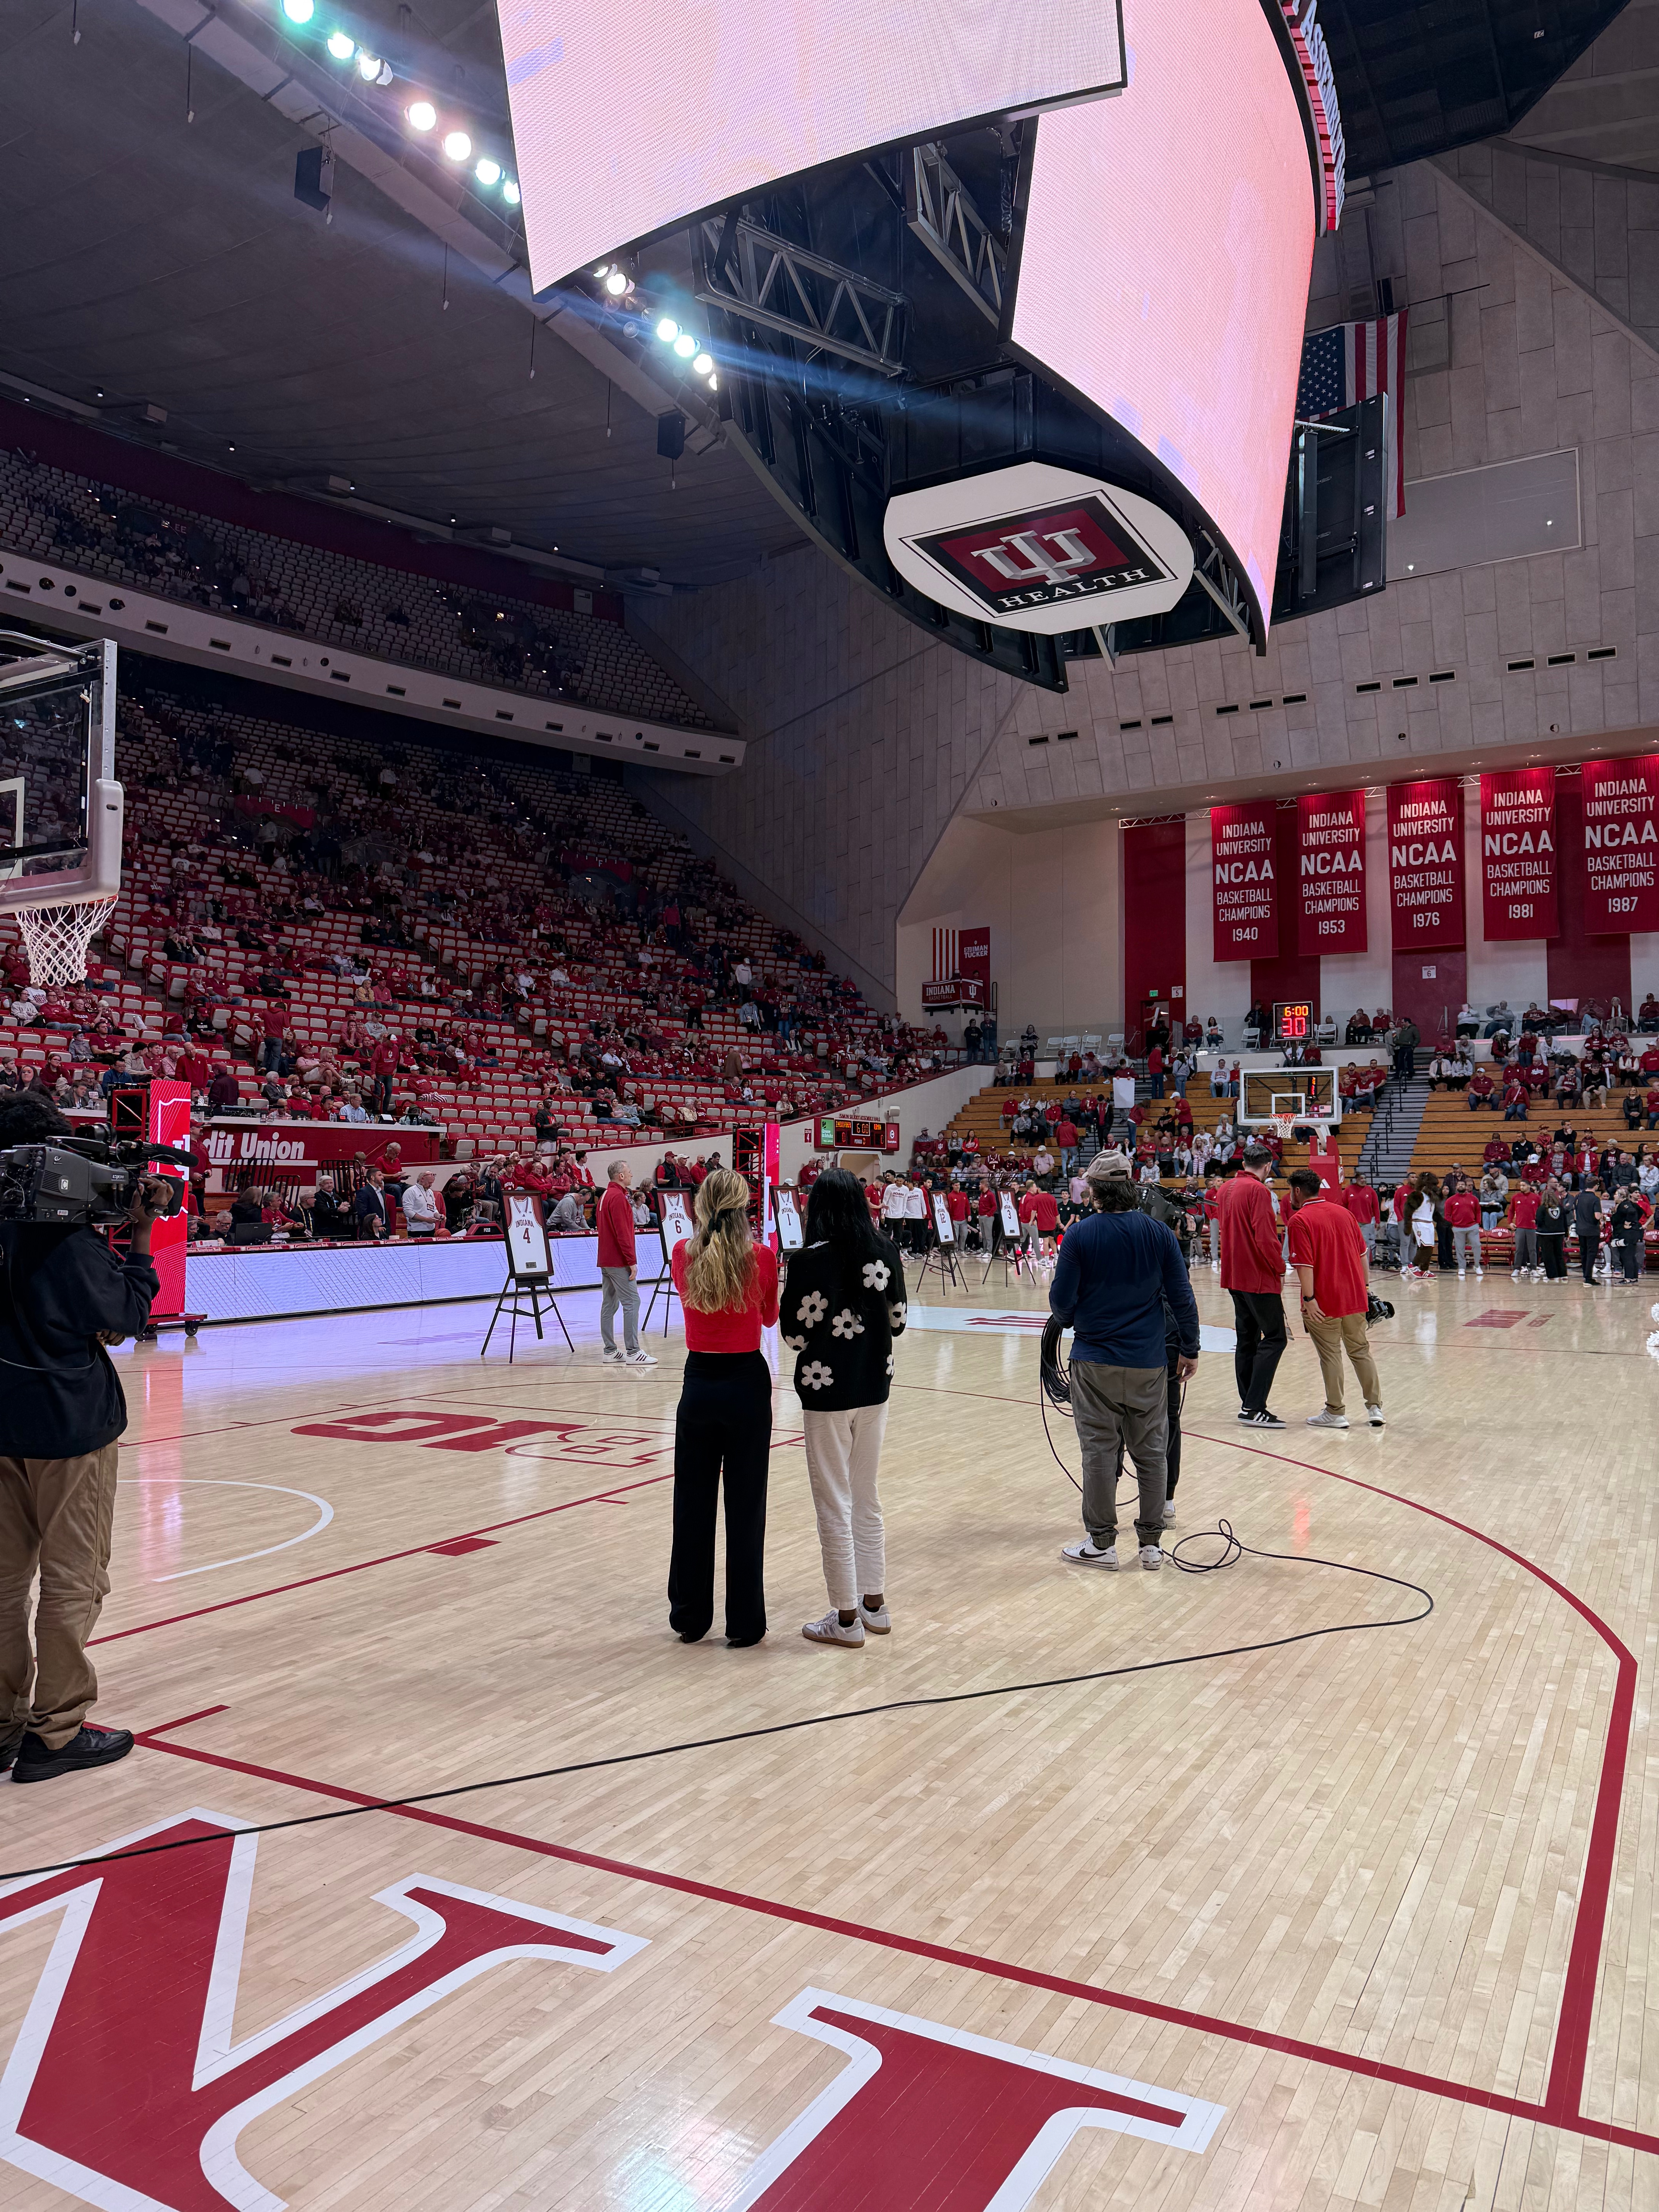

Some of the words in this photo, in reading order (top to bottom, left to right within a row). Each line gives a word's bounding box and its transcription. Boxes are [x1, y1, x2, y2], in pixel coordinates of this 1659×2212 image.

[998, 568, 1150, 607] HEALTH
[1595, 778, 1647, 797] INDIANA
[1494, 789, 1543, 807] INDIANA
[1587, 795, 1655, 817] UNIVERSITY
[1400, 800, 1447, 819] INDIANA
[1486, 807, 1551, 826] UNIVERSITY
[1309, 811, 1353, 828] INDIANA
[1393, 817, 1454, 837] UNIVERSITY
[1223, 821, 1265, 838] INDIANA
[1302, 828, 1360, 847] UNIVERSITY
[1585, 820, 1658, 848] NCAA
[1216, 837, 1271, 856] UNIVERSITY
[1485, 830, 1554, 856] NCAA
[1392, 840, 1456, 868] NCAA
[1587, 852, 1657, 872] BASKETBALL
[1216, 859, 1274, 884] NCAA
[1301, 850, 1363, 876] NCAA
[1487, 860, 1552, 879] BASKETBALL
[1303, 879, 1361, 897] BASKETBALL
[1394, 870, 1455, 890] BASKETBALL
[1490, 879, 1550, 896] CHAMPIONS
[1591, 871, 1654, 890] CHAMPIONS
[1217, 888, 1273, 905] BASKETBALL
[1397, 888, 1453, 907] CHAMPIONS
[1608, 896, 1638, 913] 1987
[1219, 905, 1270, 922] CHAMPIONS
[1305, 897, 1359, 914] CHAMPIONS
[1509, 903, 1533, 919] 1981
[1319, 919, 1345, 935] 1953
[1413, 912, 1440, 928] 1976
[1233, 927, 1258, 942] 1940
[926, 985, 955, 996] INDIANA
[1285, 1005, 1309, 1017] 6:00
[1282, 1017, 1305, 1036] 30
[857, 1123, 869, 1133] 6:00
[240, 1132, 305, 1159] Union
[842, 1132, 846, 1142] 0
[62, 1180, 68, 1189] C
[668, 1212, 685, 1221] INDIANA
[787, 1213, 791, 1226] 1
[940, 1213, 946, 1223] 12
[1007, 1210, 1011, 1219] 3
[515, 1219, 534, 1228] INDIANA
[675, 1220, 682, 1234] 6
[523, 1228, 531, 1243] 4
